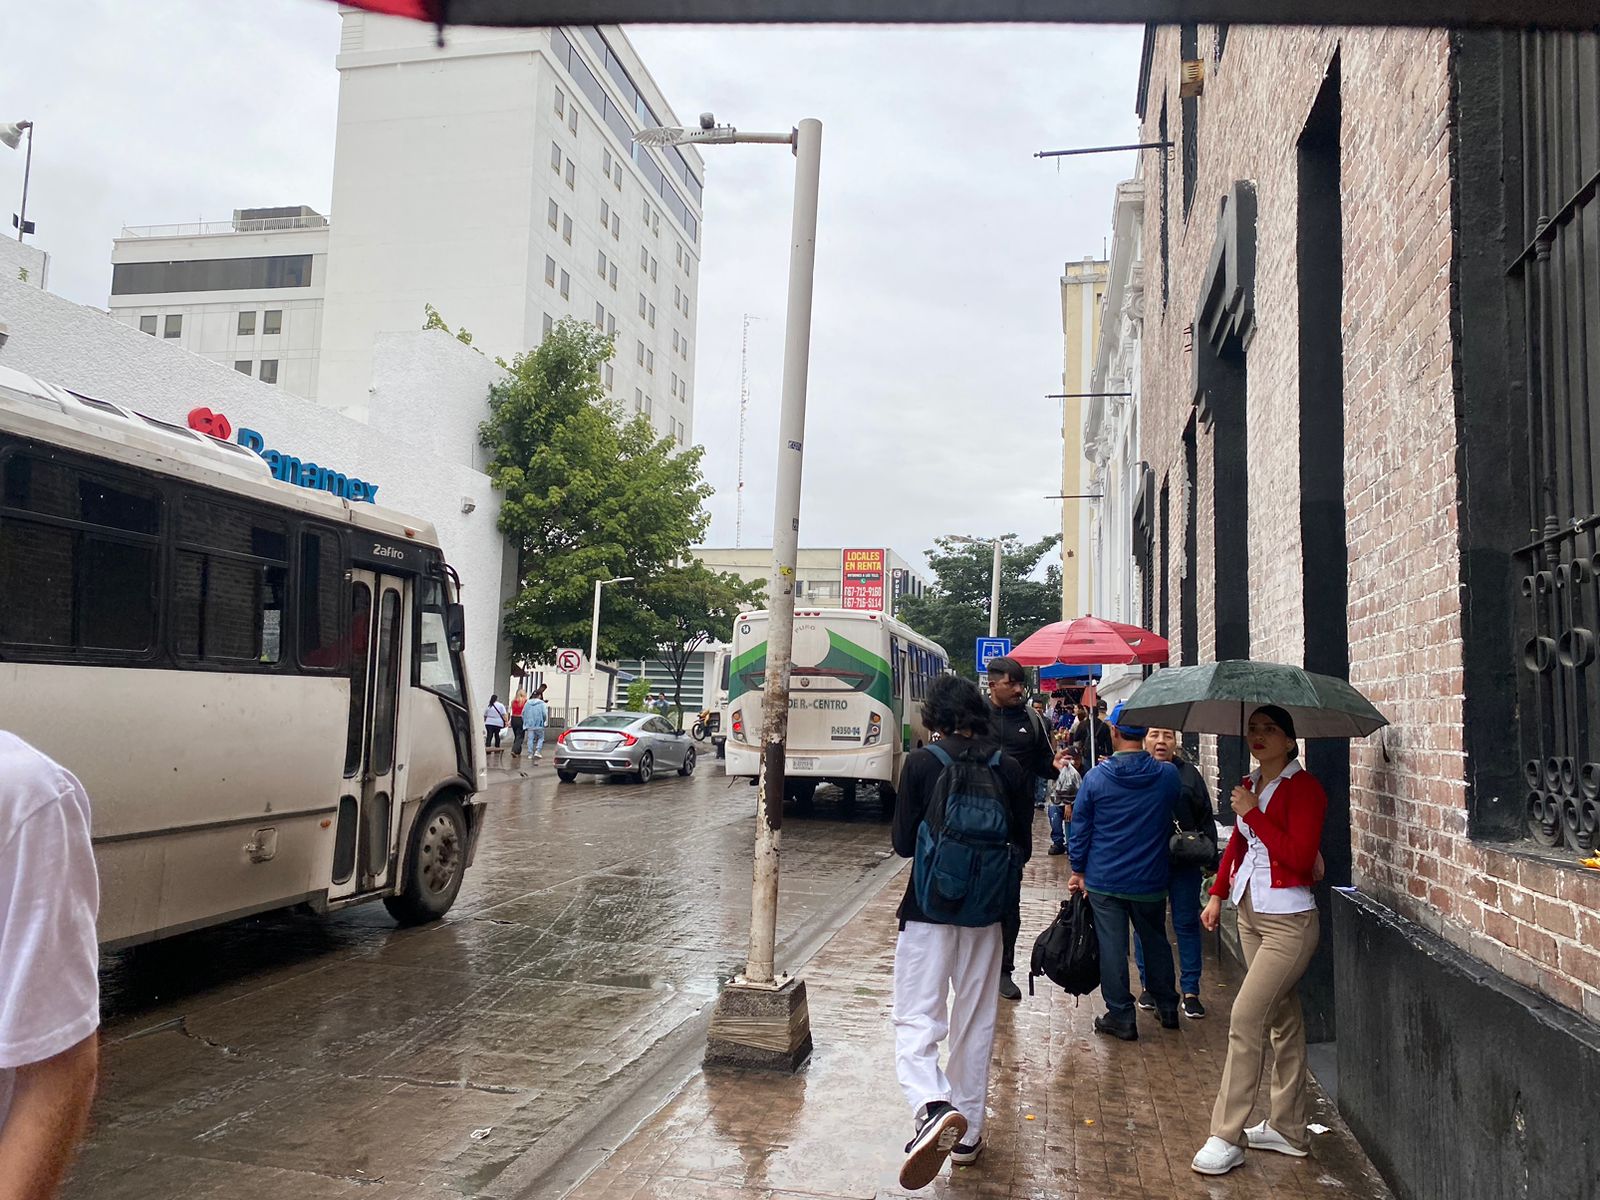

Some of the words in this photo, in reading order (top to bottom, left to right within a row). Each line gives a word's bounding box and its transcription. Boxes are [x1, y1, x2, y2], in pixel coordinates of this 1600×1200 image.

[847, 552, 879, 560] LOCALES
[845, 562, 855, 570] EN
[857, 562, 881, 570] RENTA
